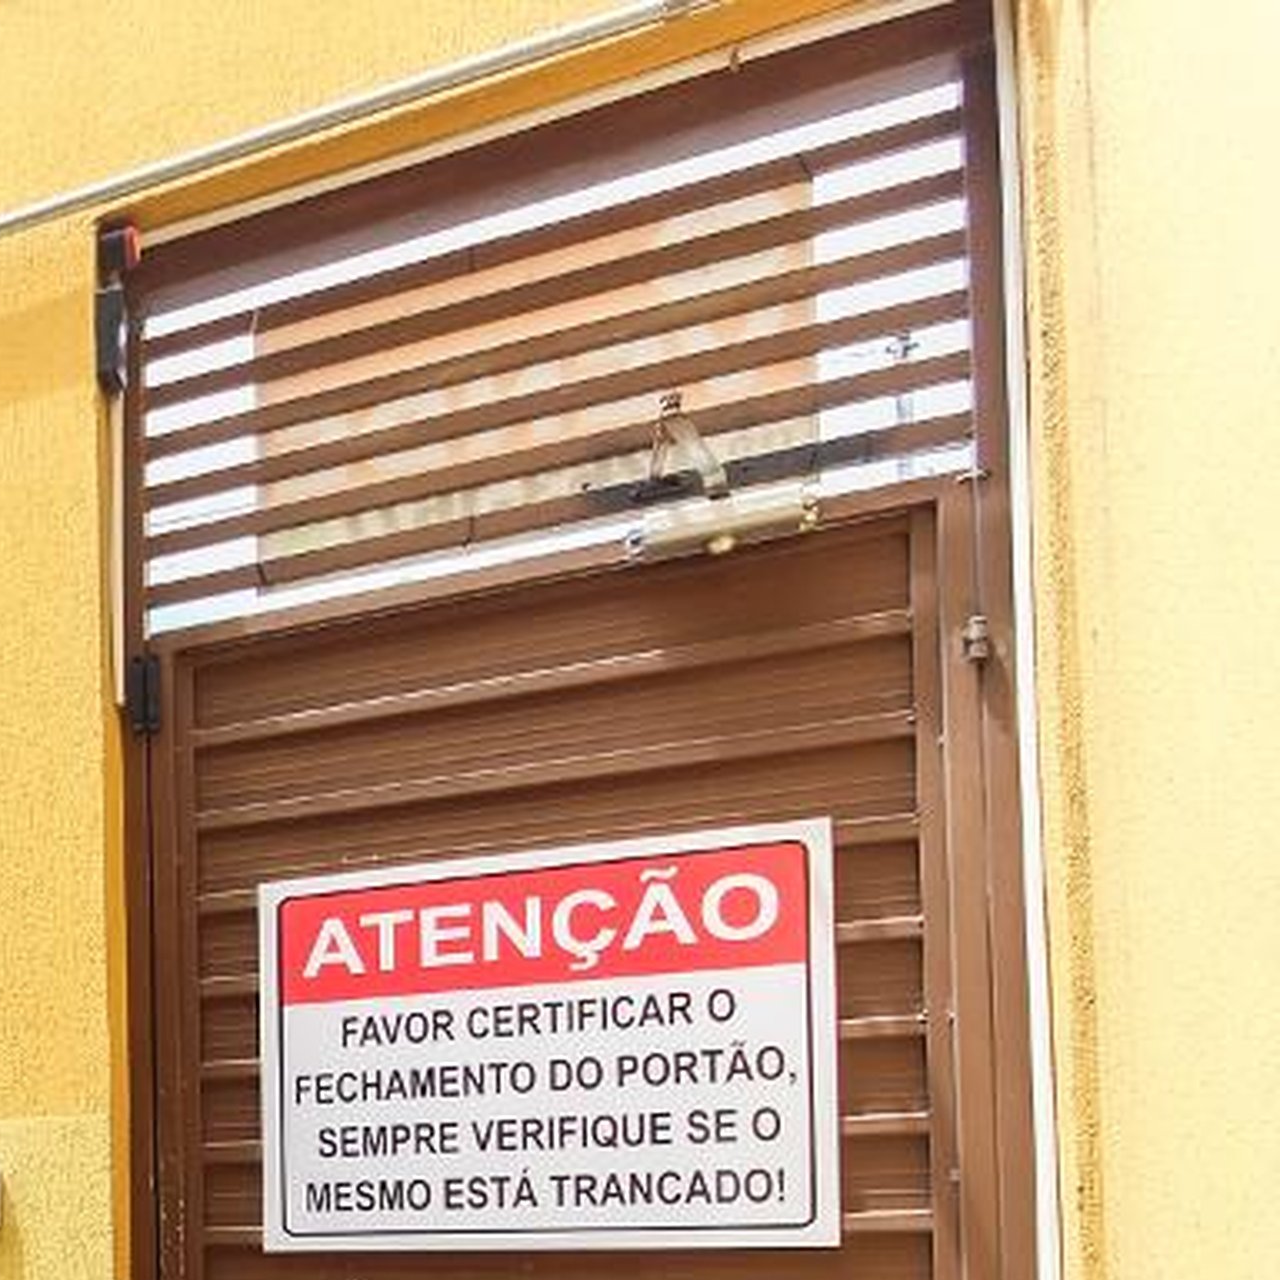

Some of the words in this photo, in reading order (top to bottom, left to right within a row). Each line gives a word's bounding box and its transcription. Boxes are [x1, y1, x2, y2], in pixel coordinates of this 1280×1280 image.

[303, 865, 780, 977] ATENÇÃO
[341, 1009, 455, 1047] FAVOR
[467, 992, 693, 1039] CERTIFICAR
[708, 989, 736, 1022] O
[295, 1061, 536, 1105] FECHAMENTO
[549, 1057, 604, 1091] DO
[617, 1040, 797, 1087] PORTÃO,
[318, 1122, 460, 1158] SEMPRE
[472, 1112, 673, 1151] VERIFIQUE
[687, 1109, 738, 1144] SE
[752, 1106, 782, 1142] O
[306, 1178, 432, 1213] MESMO
[444, 1167, 539, 1210] ESTÁ
[549, 1167, 786, 1207] TRANCADO!
